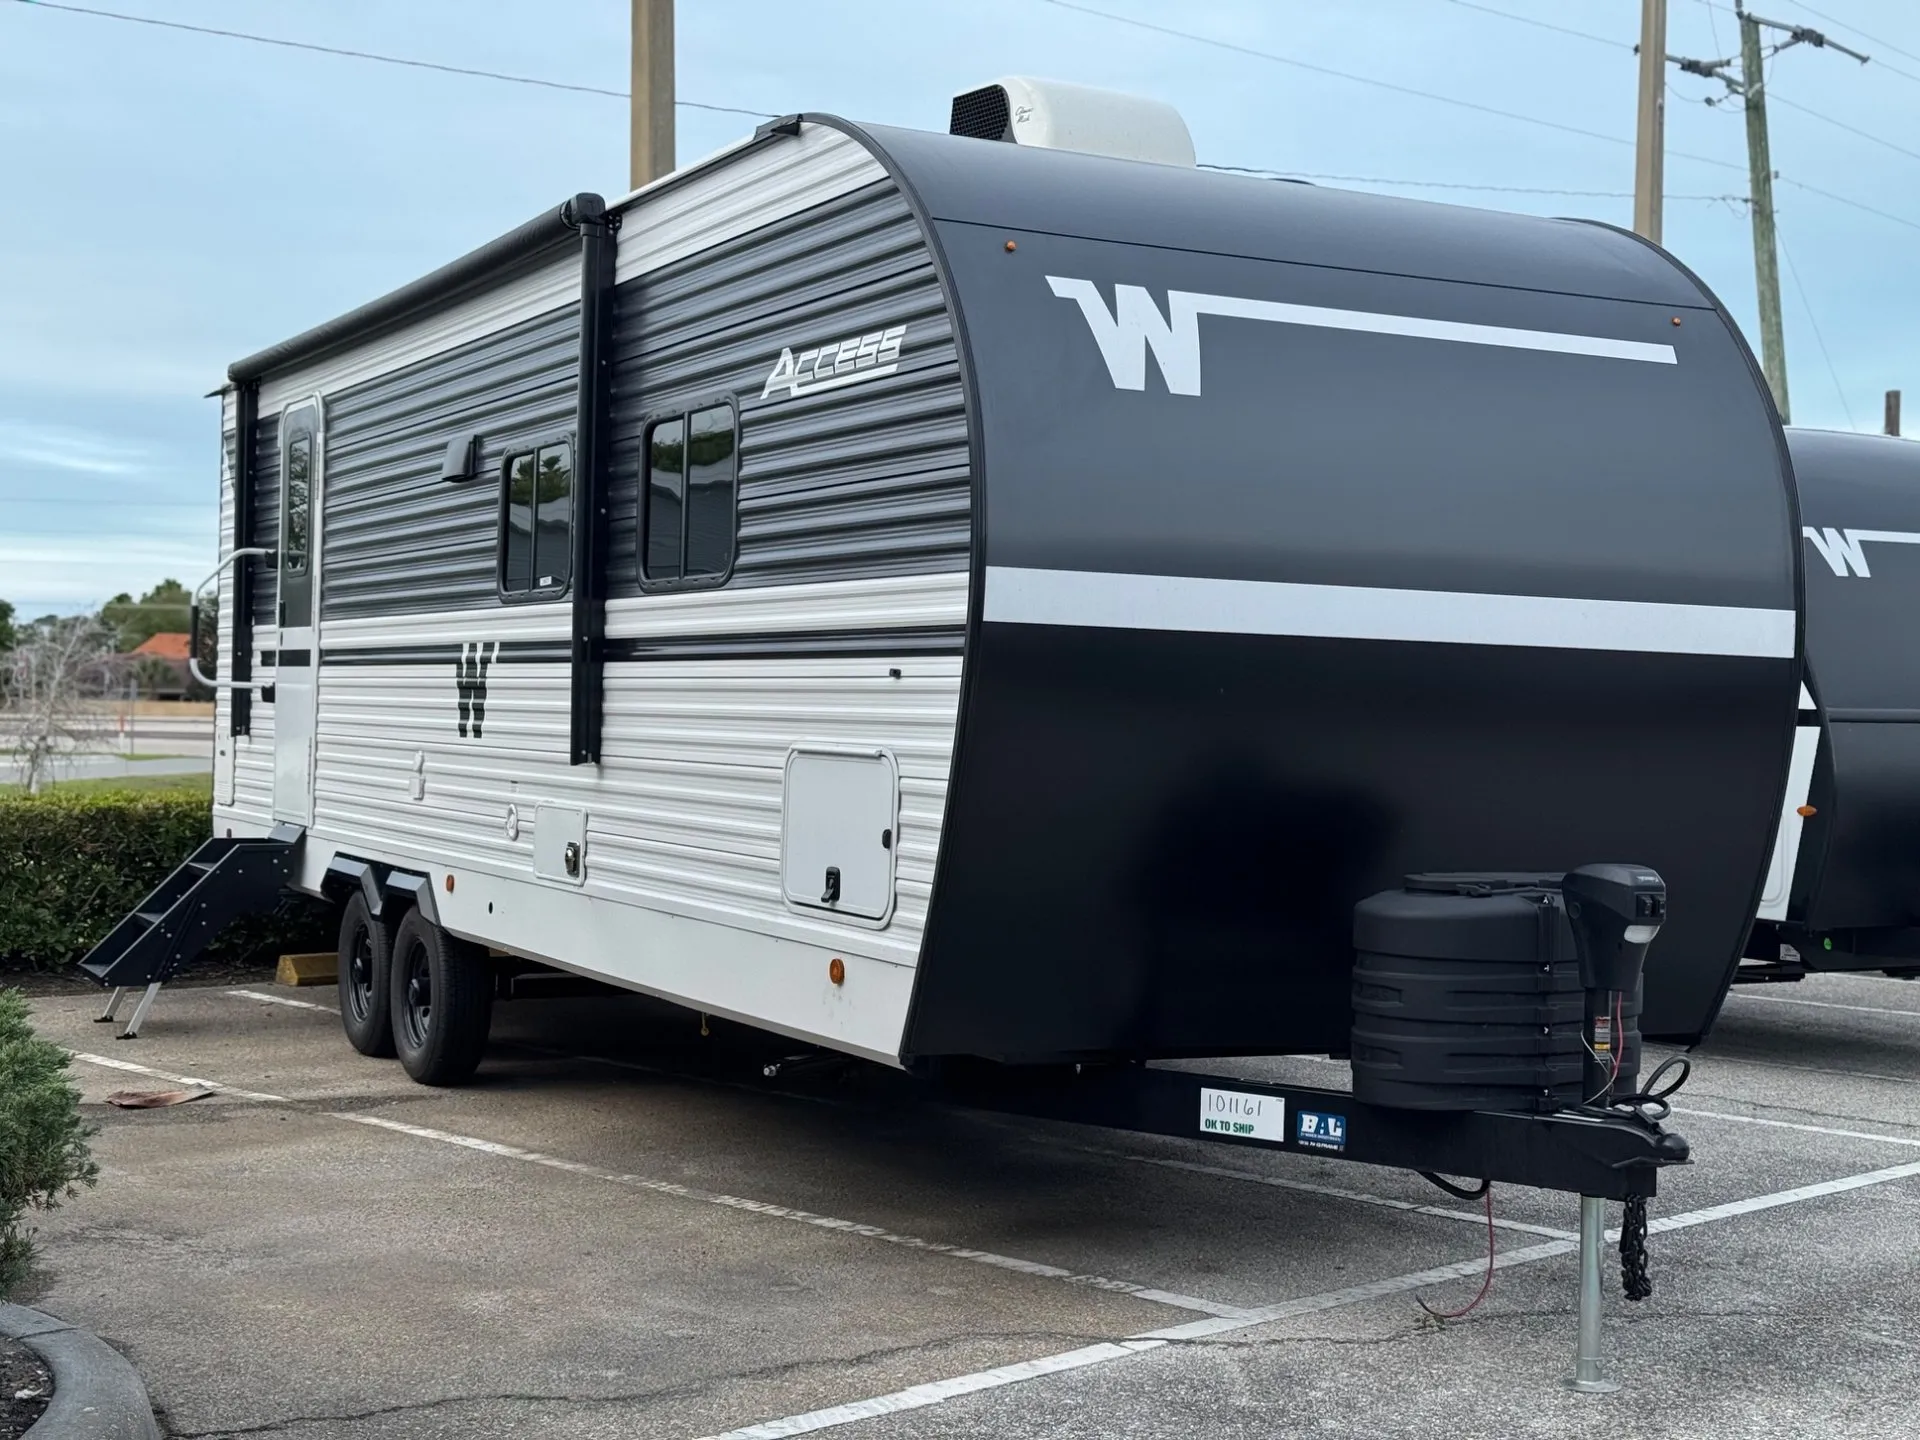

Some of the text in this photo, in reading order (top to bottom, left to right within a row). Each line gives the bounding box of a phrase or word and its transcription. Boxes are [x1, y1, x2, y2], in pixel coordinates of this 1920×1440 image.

[760, 325, 907, 400] ACCESS
[1208, 1093, 1262, 1117] 101161
[1205, 1118, 1255, 1135] OK TO SHIP
